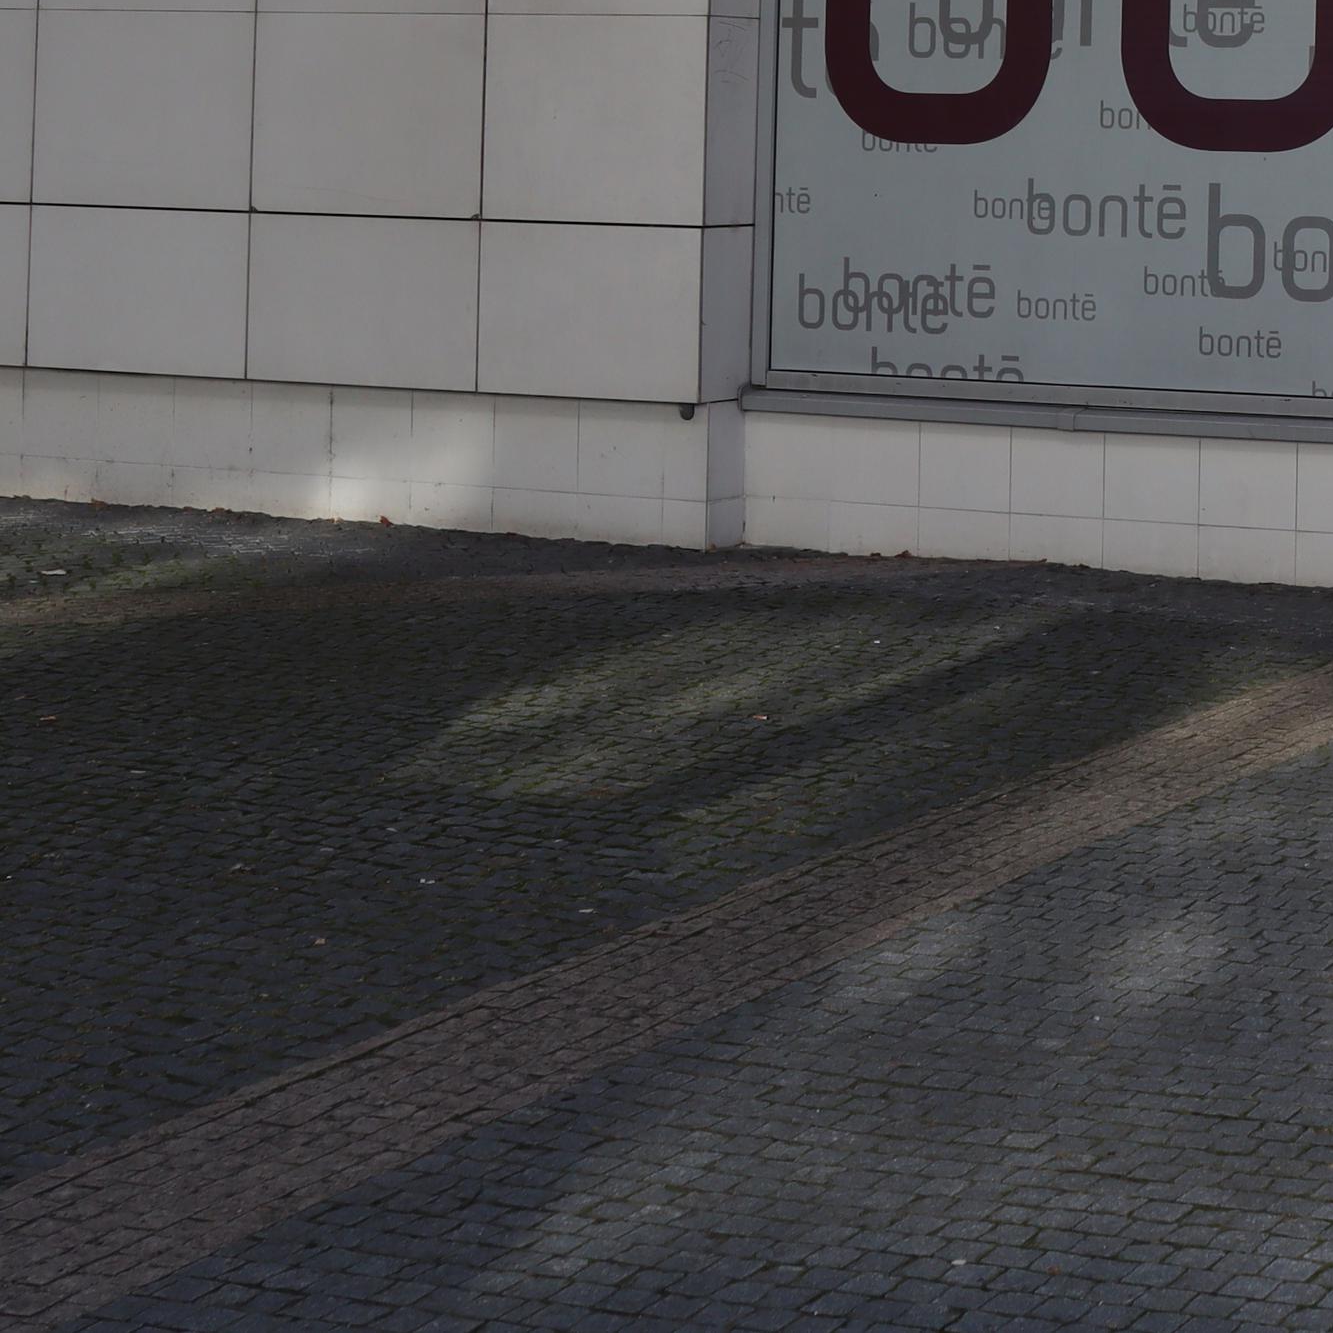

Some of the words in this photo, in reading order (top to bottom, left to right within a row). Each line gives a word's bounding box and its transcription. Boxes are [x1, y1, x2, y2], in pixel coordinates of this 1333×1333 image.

[1027, 178, 1186, 240] bontē
[1017, 289, 1096, 322] bontē
[1199, 326, 1282, 359] bontē
